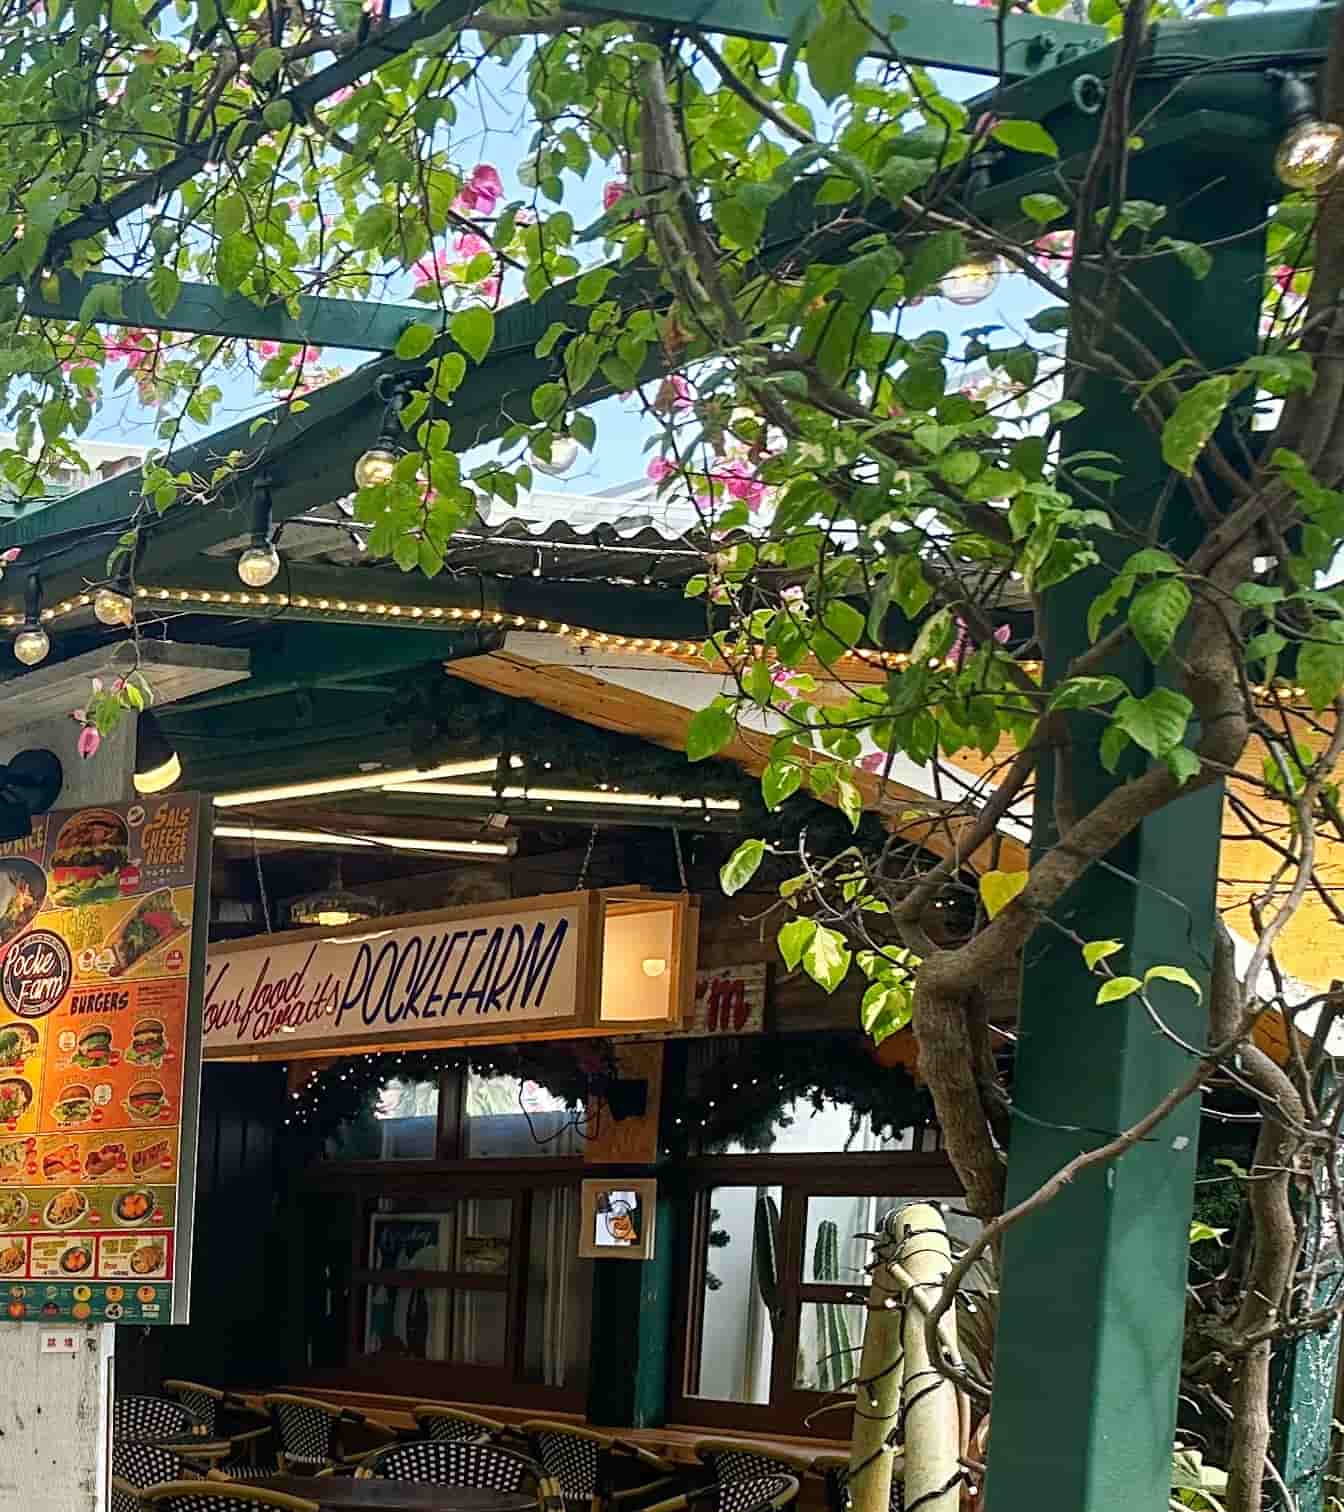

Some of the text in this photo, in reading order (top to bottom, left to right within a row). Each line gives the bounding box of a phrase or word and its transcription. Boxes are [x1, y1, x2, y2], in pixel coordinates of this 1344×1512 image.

[3, 944, 56, 977] Pocke
[238, 943, 317, 1039] food
[334, 918, 569, 1027] POCKEFARM
[16, 974, 63, 1013] Farm
[70, 990, 129, 1016] BURGERS
